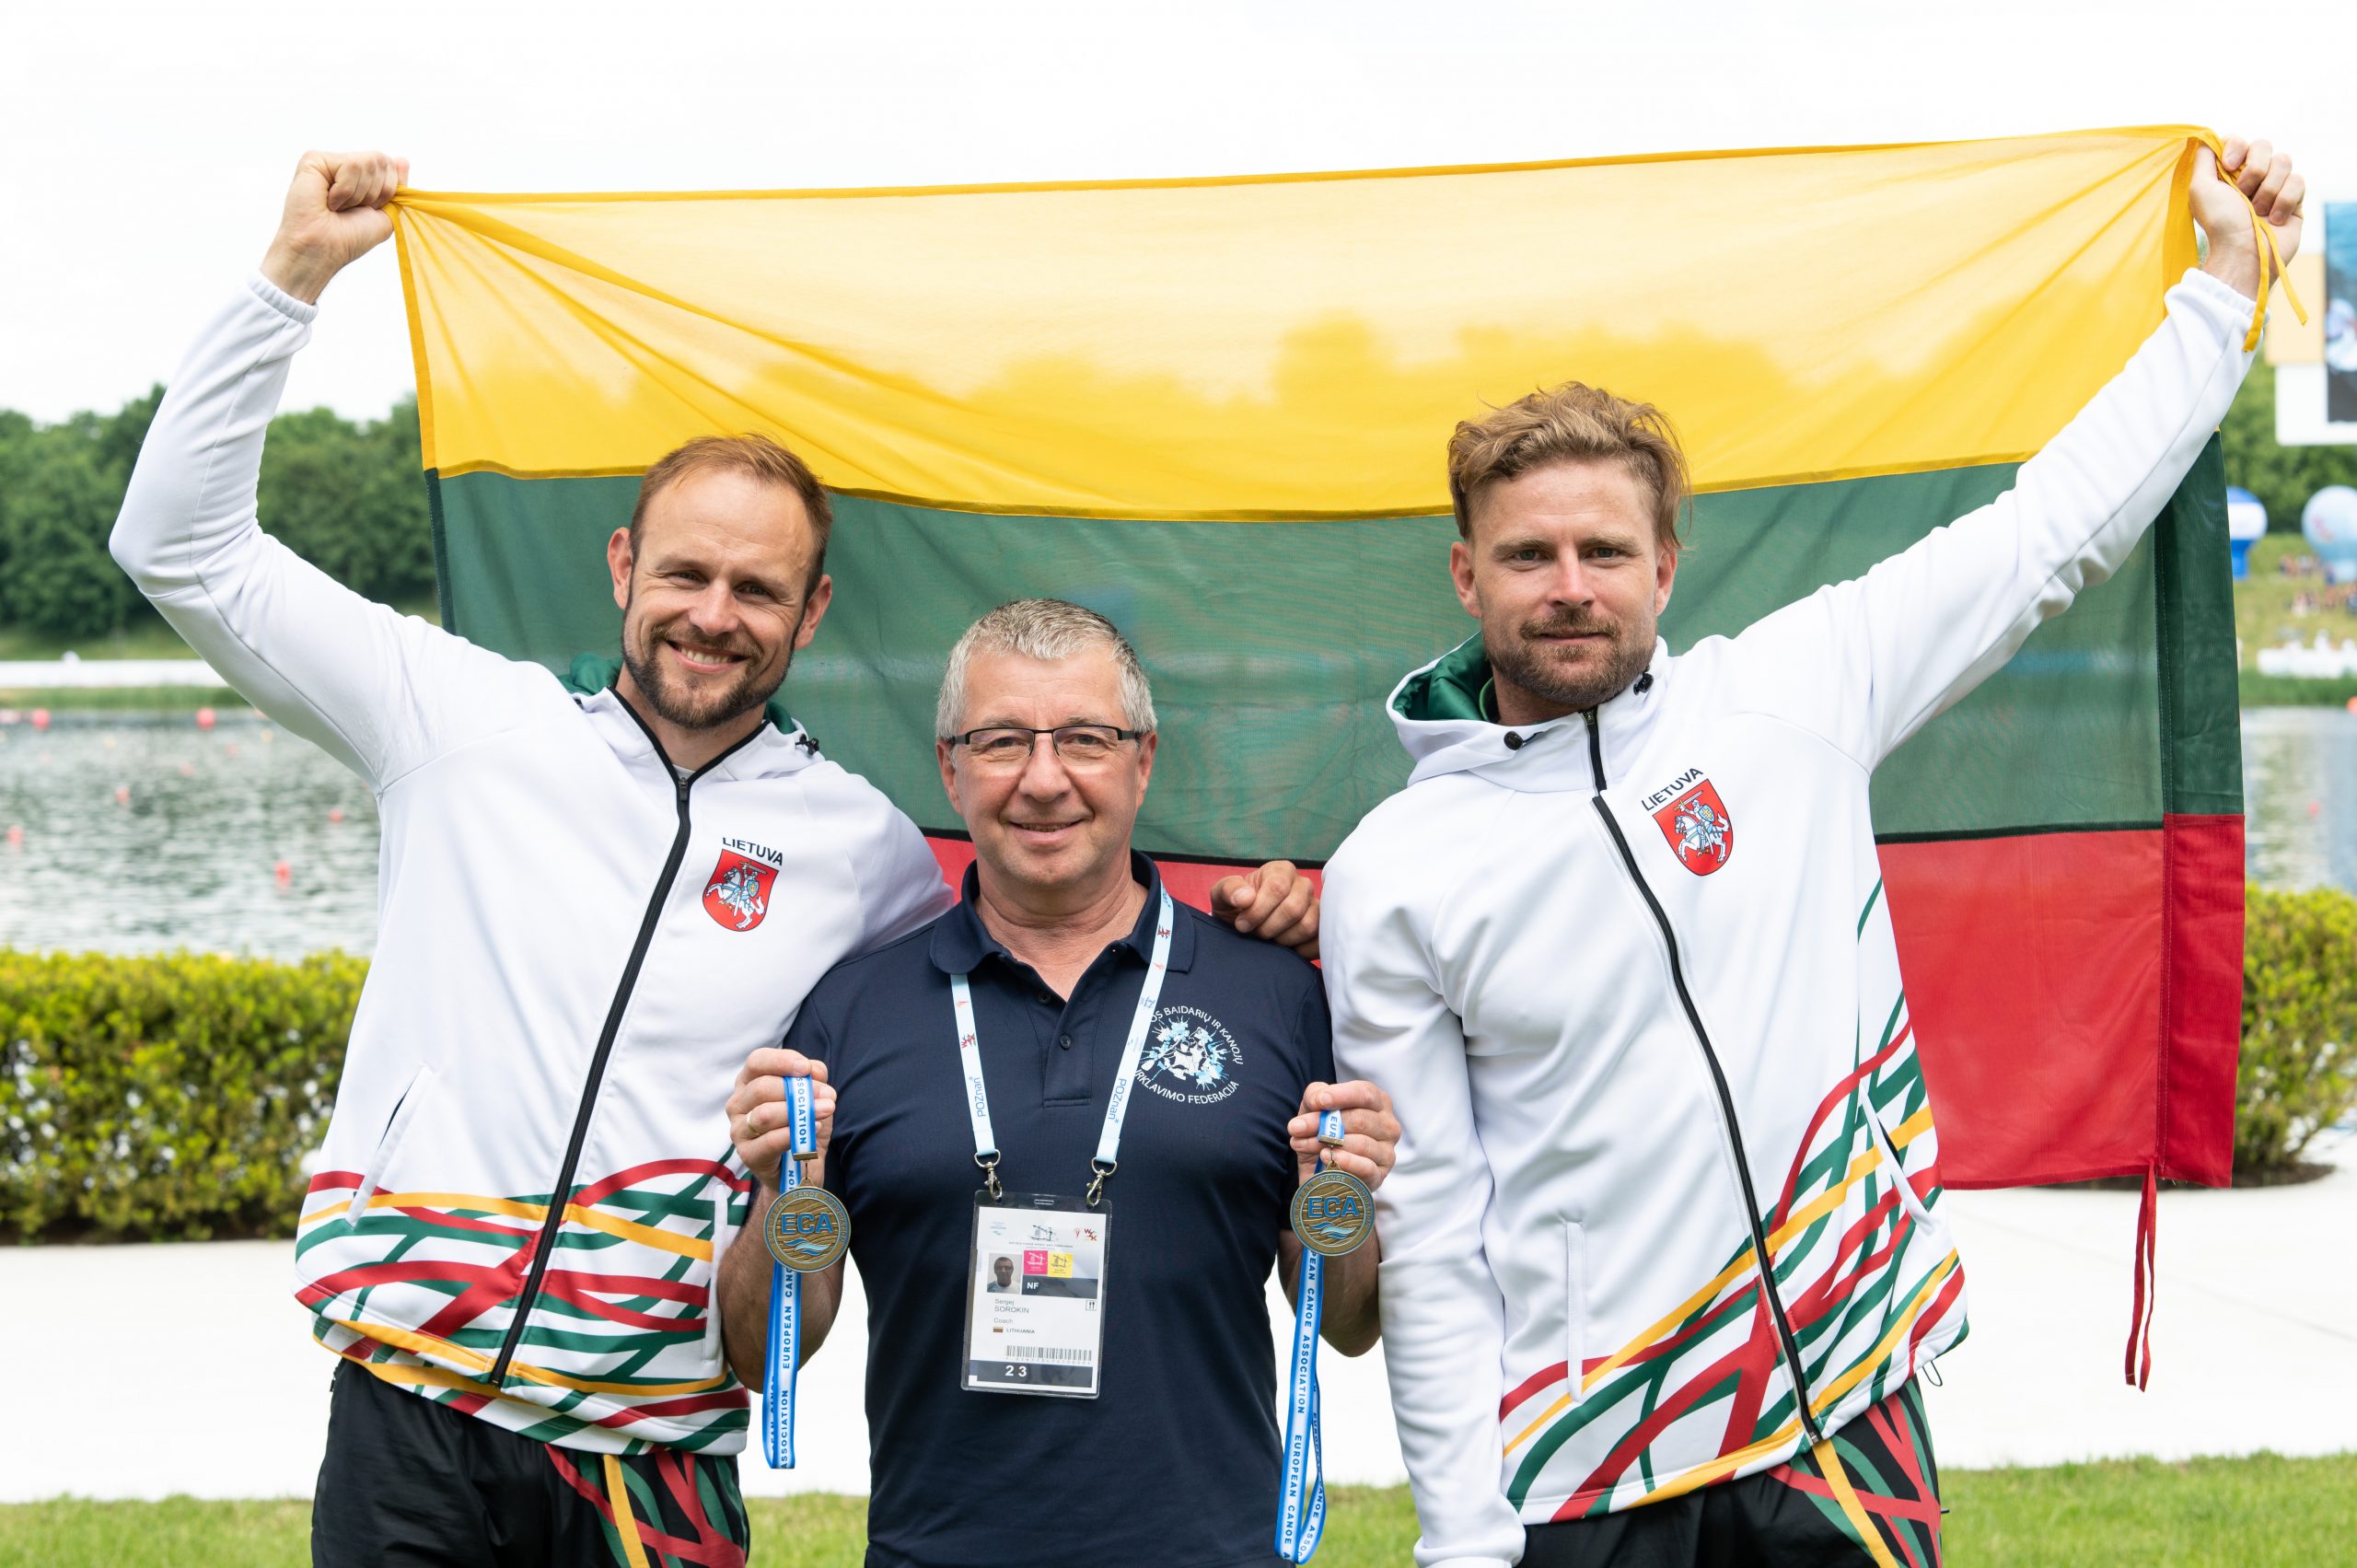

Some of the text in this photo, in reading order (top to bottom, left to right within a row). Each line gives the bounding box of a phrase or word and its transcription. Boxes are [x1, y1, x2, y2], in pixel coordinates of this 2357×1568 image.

[1641, 768, 1704, 811] LIETUVA
[722, 837, 784, 866] LIETUVA
[1211, 1019, 1222, 1030] IR
[1188, 1080, 1240, 1105] FEDERACIJA
[781, 1213, 833, 1235] ECA
[1307, 1196, 1360, 1218] ECA
[1027, 1282, 1039, 1290] NF
[994, 1306, 1029, 1314] SOROKIN
[1305, 1287, 1315, 1328] CANOE
[783, 1306, 792, 1369] EUROPEAN
[1297, 1334, 1310, 1414] ASSOCIATION
[781, 1389, 789, 1469] ASSOCIATION
[1289, 1434, 1302, 1497] EUROPEAN
[1284, 1505, 1295, 1545] CANOE
